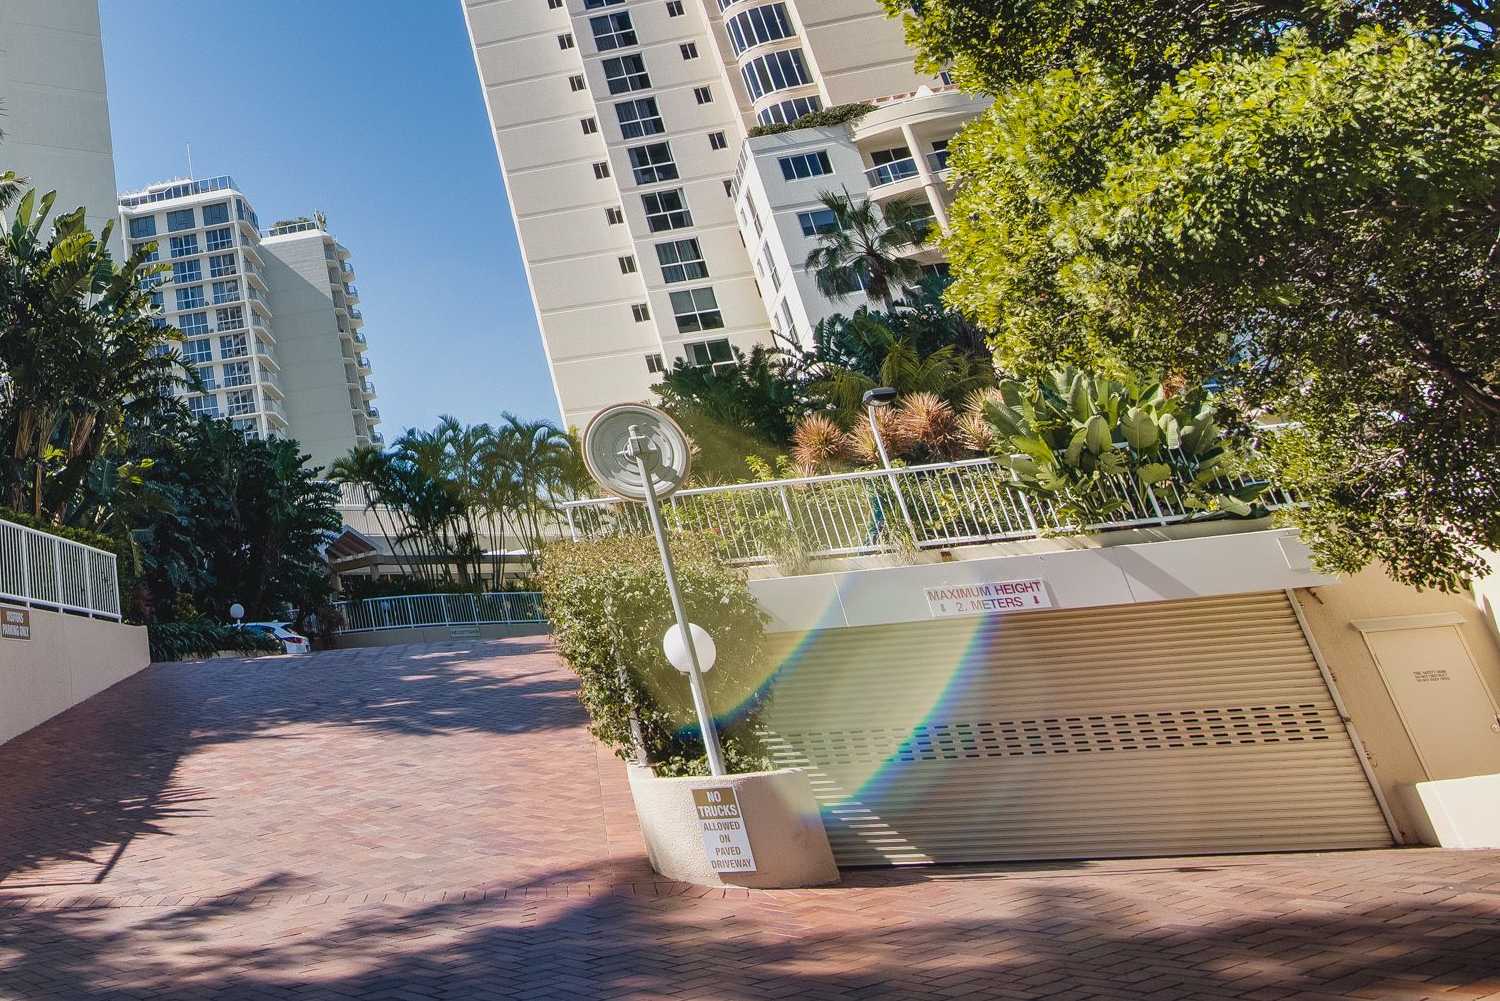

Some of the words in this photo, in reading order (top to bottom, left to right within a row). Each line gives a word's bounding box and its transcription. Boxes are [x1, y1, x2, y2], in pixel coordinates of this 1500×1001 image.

[927, 586, 991, 601] MAXIMUM
[995, 581, 1041, 596] HEIGHT
[971, 597, 1024, 611] METERS
[706, 791, 721, 802] NO
[698, 804, 737, 817] TRUCKS
[703, 821, 740, 831] ALLOWED
[719, 834, 731, 843] ON
[715, 846, 741, 856] PAVED
[711, 859, 751, 869] DRIVEWAY
